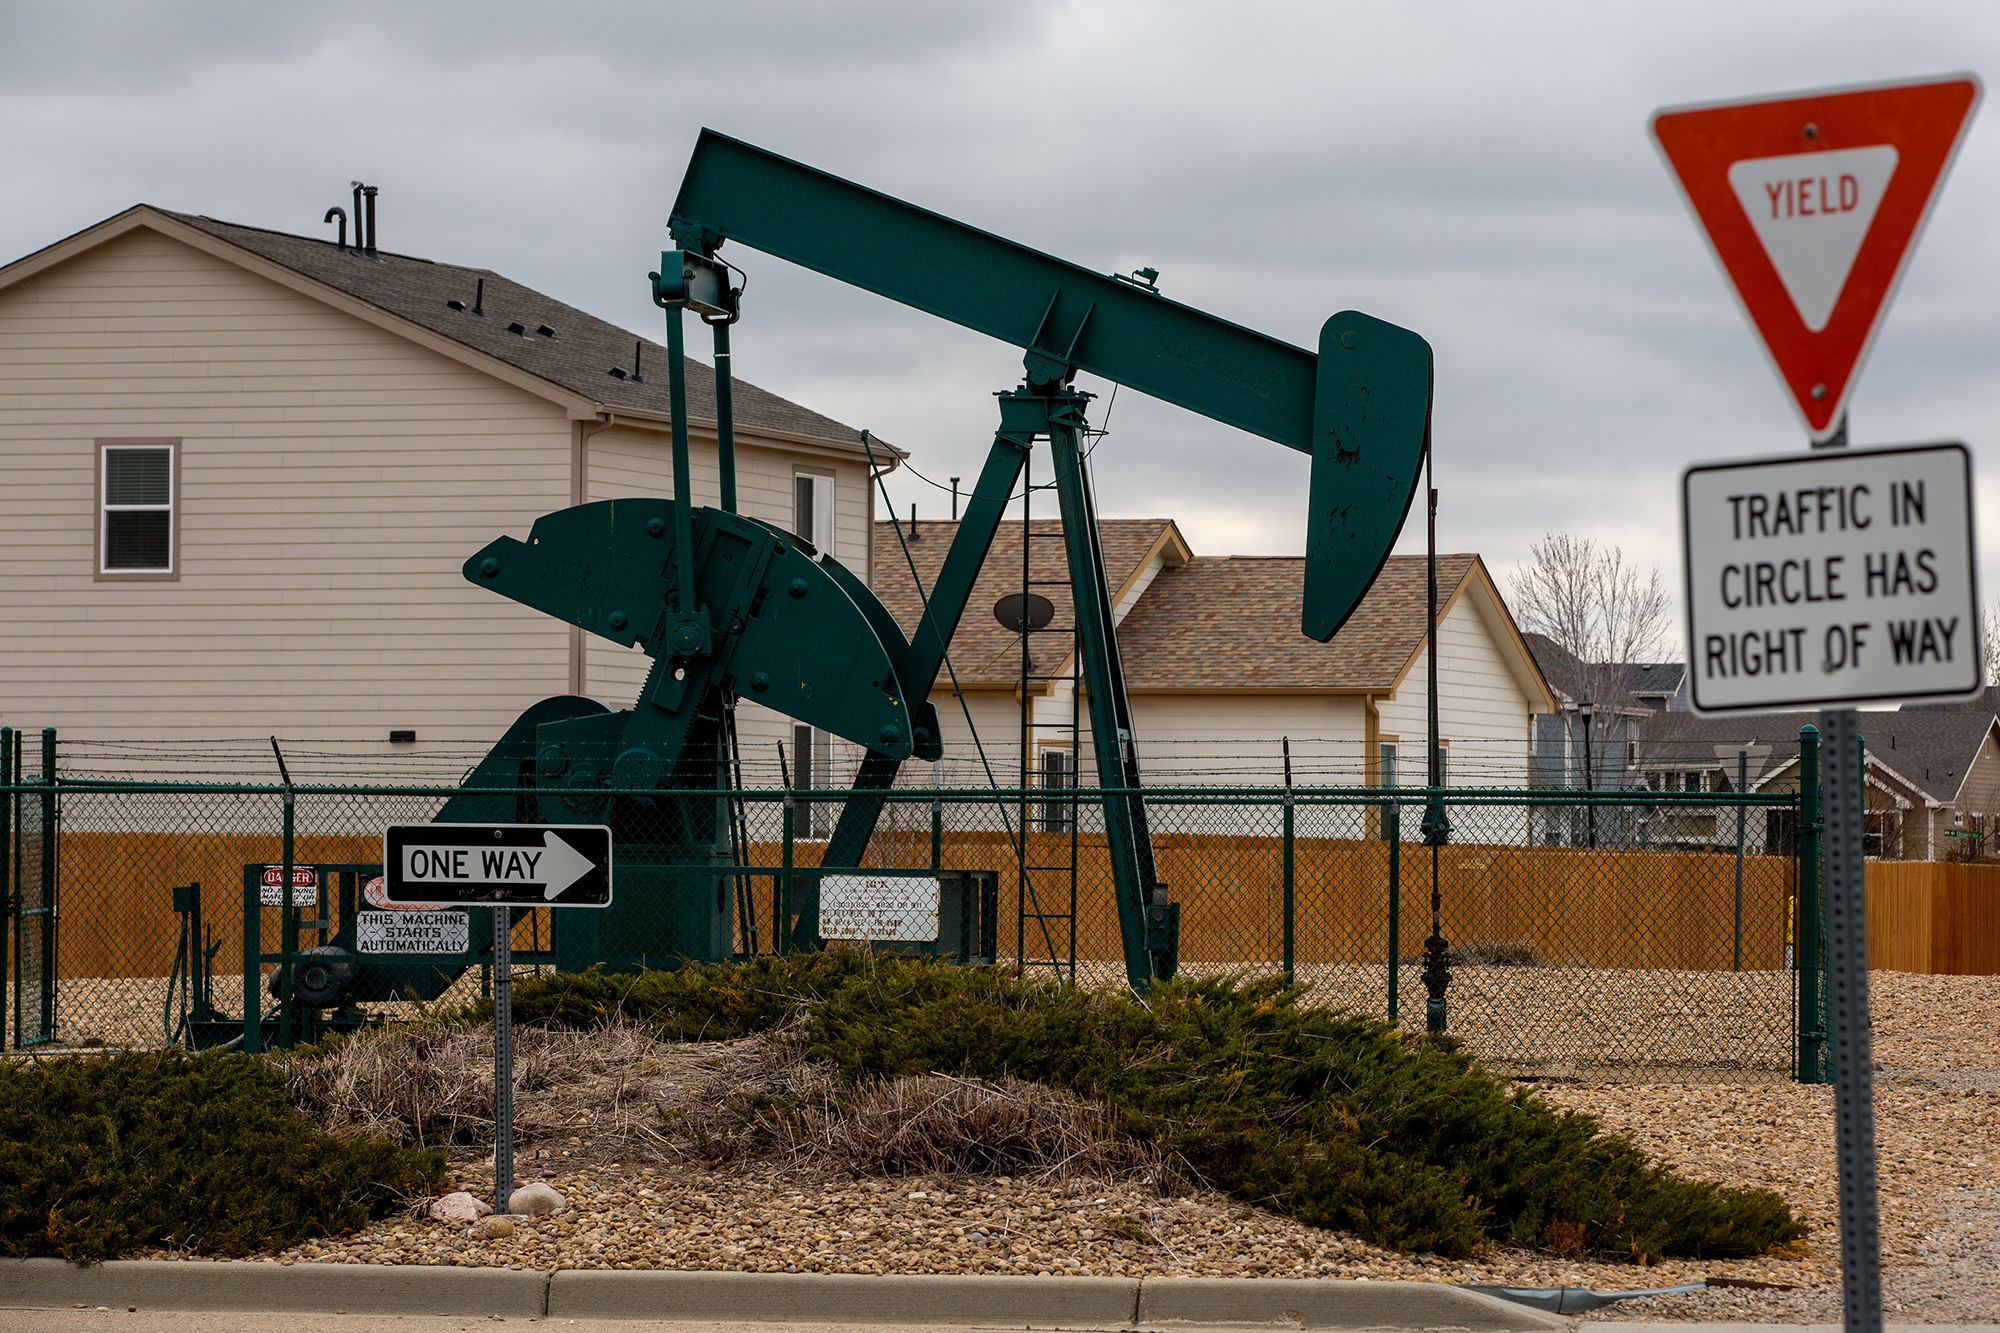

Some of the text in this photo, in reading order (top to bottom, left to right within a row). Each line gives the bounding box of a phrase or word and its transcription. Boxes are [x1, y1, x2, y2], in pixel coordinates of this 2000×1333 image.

[1765, 173, 1859, 220] YIELD
[1727, 479, 1926, 540] TRAFFIC IN
[1721, 549, 1938, 609] CIRCLE HAS
[1705, 615, 1958, 679] RIGHT OF WAY
[268, 872, 309, 882] DAGER
[410, 849, 543, 879] ONE WAY
[360, 914, 467, 925] THIS MACHINE
[386, 927, 441, 938] STARTS
[360, 940, 467, 951] AUTOMATICALLY
